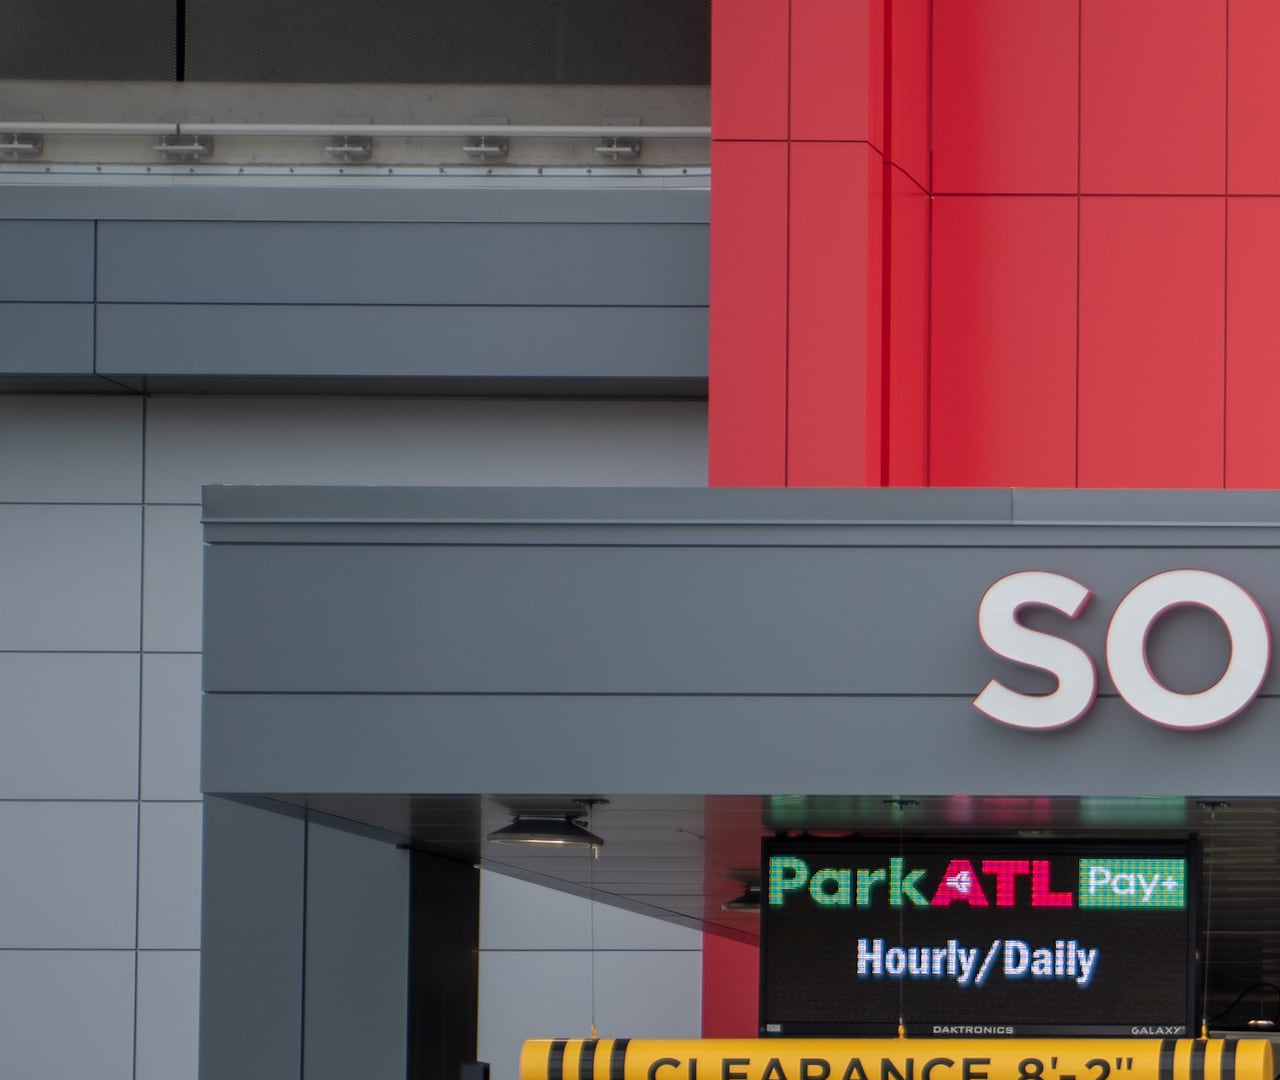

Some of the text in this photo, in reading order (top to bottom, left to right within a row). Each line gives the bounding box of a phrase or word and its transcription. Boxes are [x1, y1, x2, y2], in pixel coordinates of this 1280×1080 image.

[769, 856, 1178, 907] ParkATL Pay+
[856, 938, 1098, 985] Hourly/Daily
[932, 1025, 1014, 1035] DAKTRONICS
